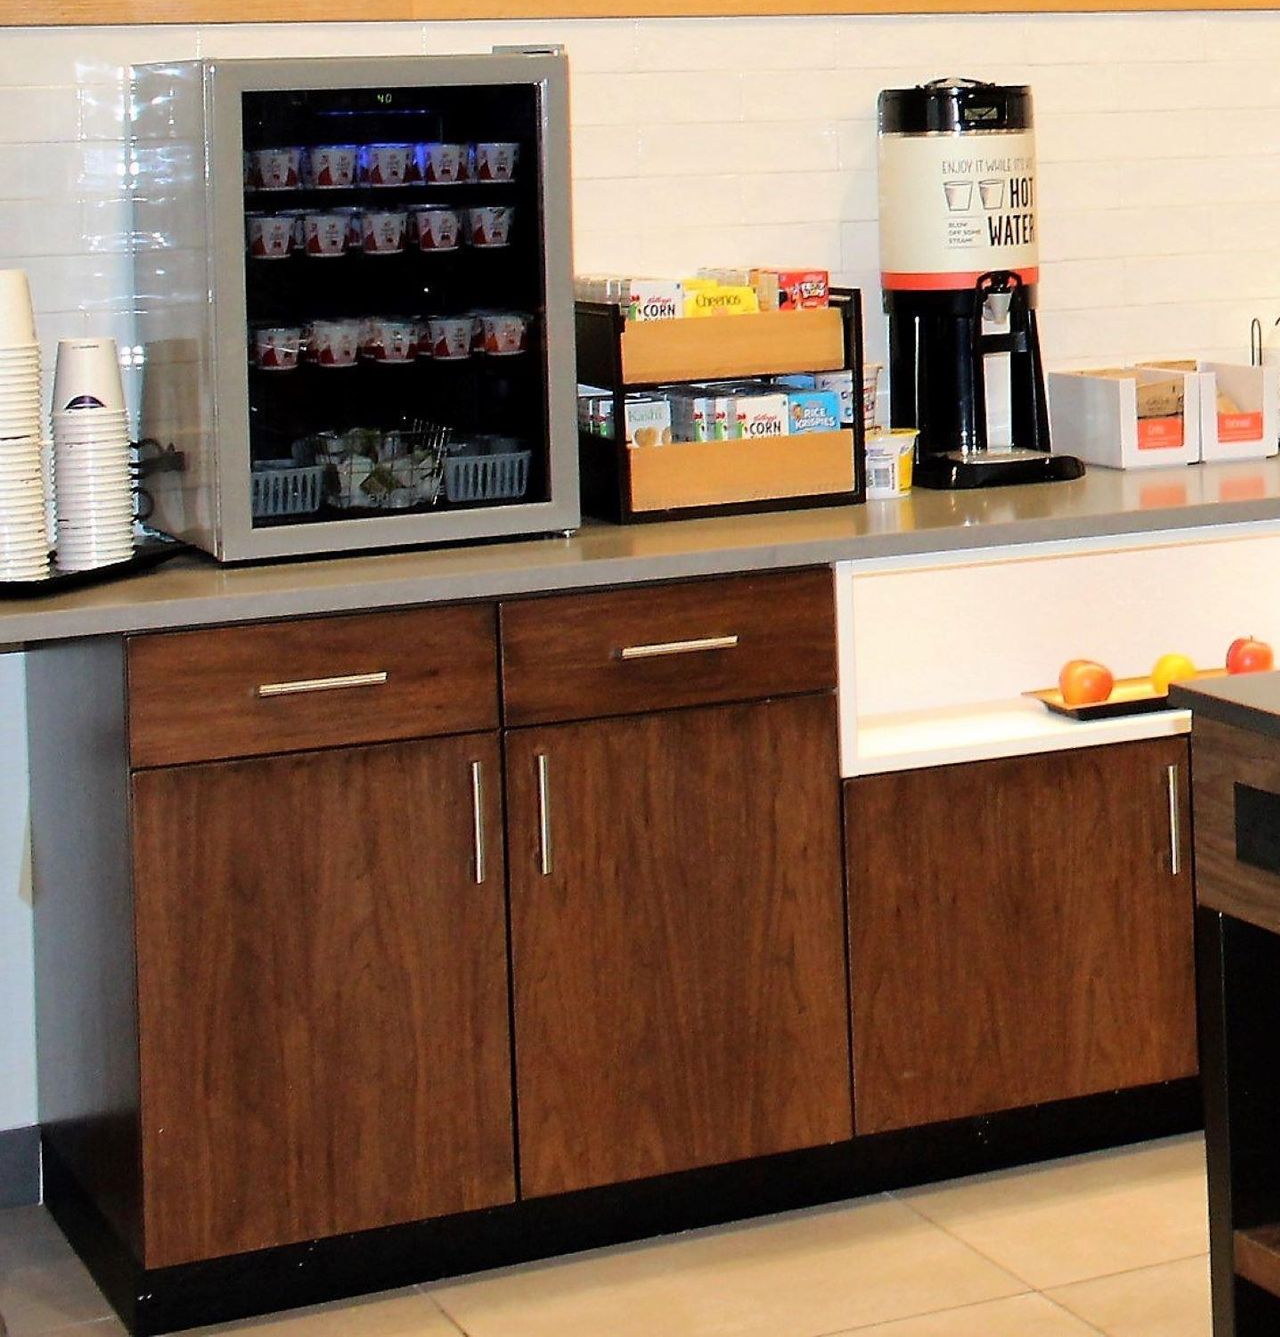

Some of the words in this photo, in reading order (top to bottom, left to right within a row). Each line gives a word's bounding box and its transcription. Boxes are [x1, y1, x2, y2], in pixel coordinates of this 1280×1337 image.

[377, 93, 392, 104] 40
[942, 160, 972, 174] ENJOY
[976, 159, 984, 172] IT
[1009, 177, 1033, 208] HOT
[987, 214, 1035, 246] WATER
[695, 294, 741, 307] Cheerios
[643, 304, 676, 317] CORN
[803, 407, 827, 418] RICE
[749, 421, 781, 435] CORN
